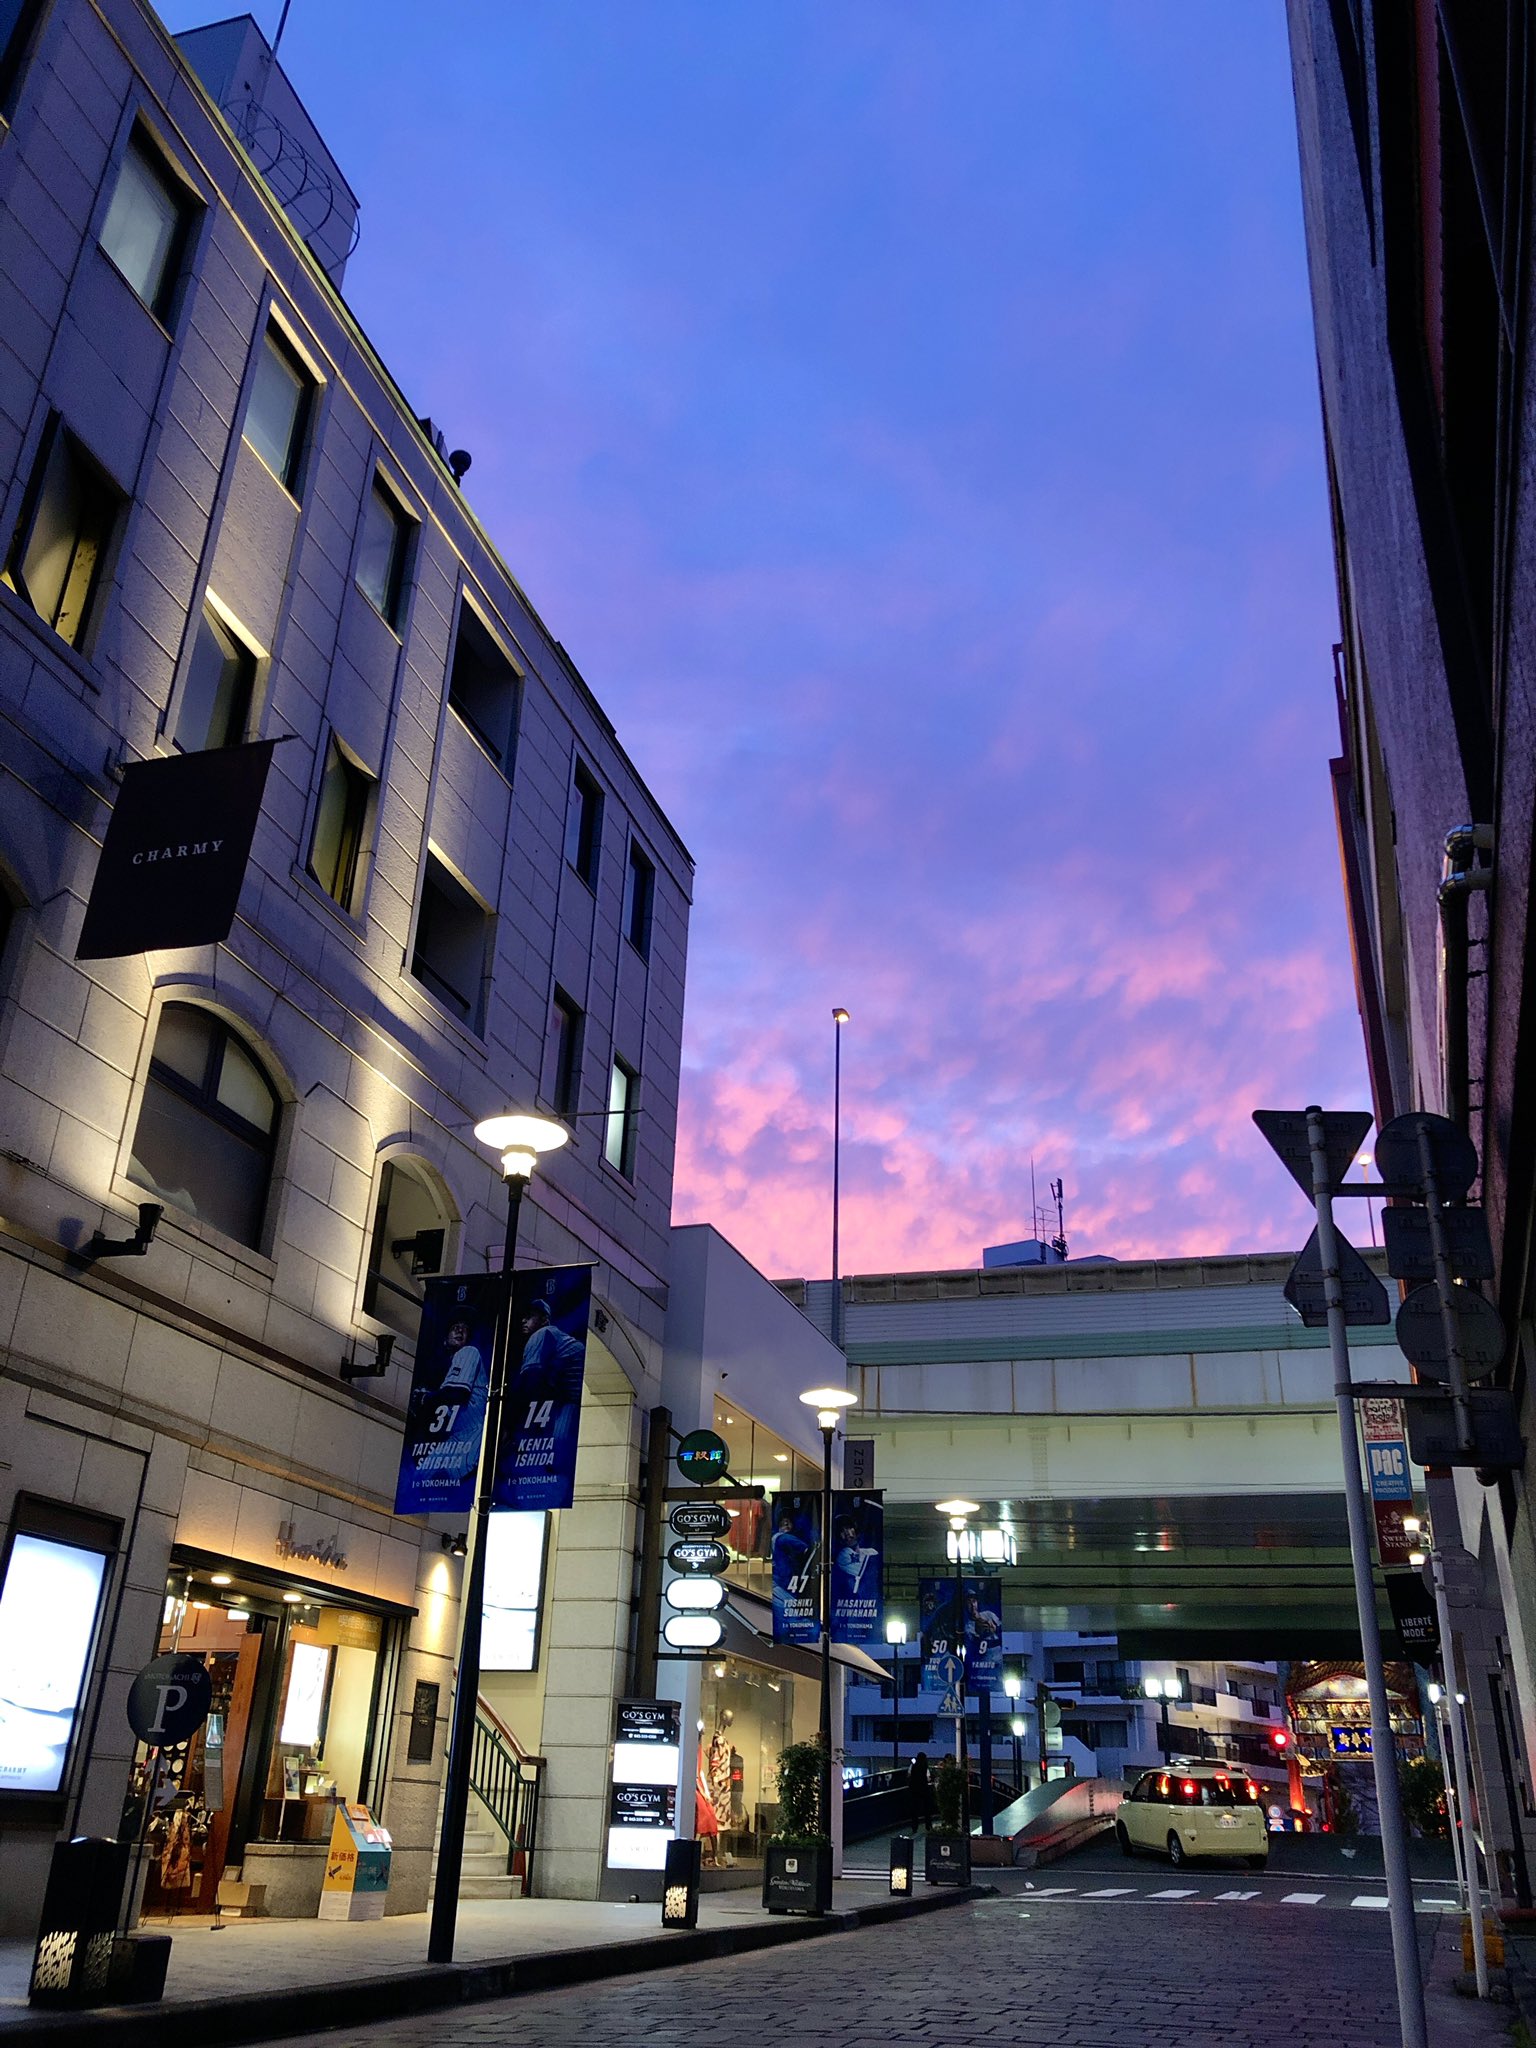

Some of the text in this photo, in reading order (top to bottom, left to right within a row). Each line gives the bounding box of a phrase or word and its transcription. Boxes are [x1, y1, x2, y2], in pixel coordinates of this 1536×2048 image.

[132, 840, 224, 865] CHARMY
[429, 1404, 460, 1433] 31
[524, 1400, 554, 1429] 14
[412, 1441, 472, 1457] TATSUHIRO
[517, 1437, 555, 1452] KENTA
[416, 1455, 462, 1471] SHIBATA
[515, 1452, 555, 1468] ISHIDA
[699, 1514, 720, 1523] GYM
[696, 1549, 718, 1557] GYM
[787, 1575, 809, 1594] 47
[783, 1598, 813, 1608] YOSHIKI
[836, 1599, 876, 1609] MASAYUKI
[835, 1608, 878, 1618] KUWAHARA
[1400, 1616, 1433, 1627] LIBERTÉ
[1402, 1628, 1426, 1638] MODE
[931, 1639, 948, 1654] 50
[978, 1640, 988, 1654] 9
[147, 1685, 188, 1733] P
[644, 1712, 665, 1720] GYM
[640, 1794, 661, 1802] GYM
